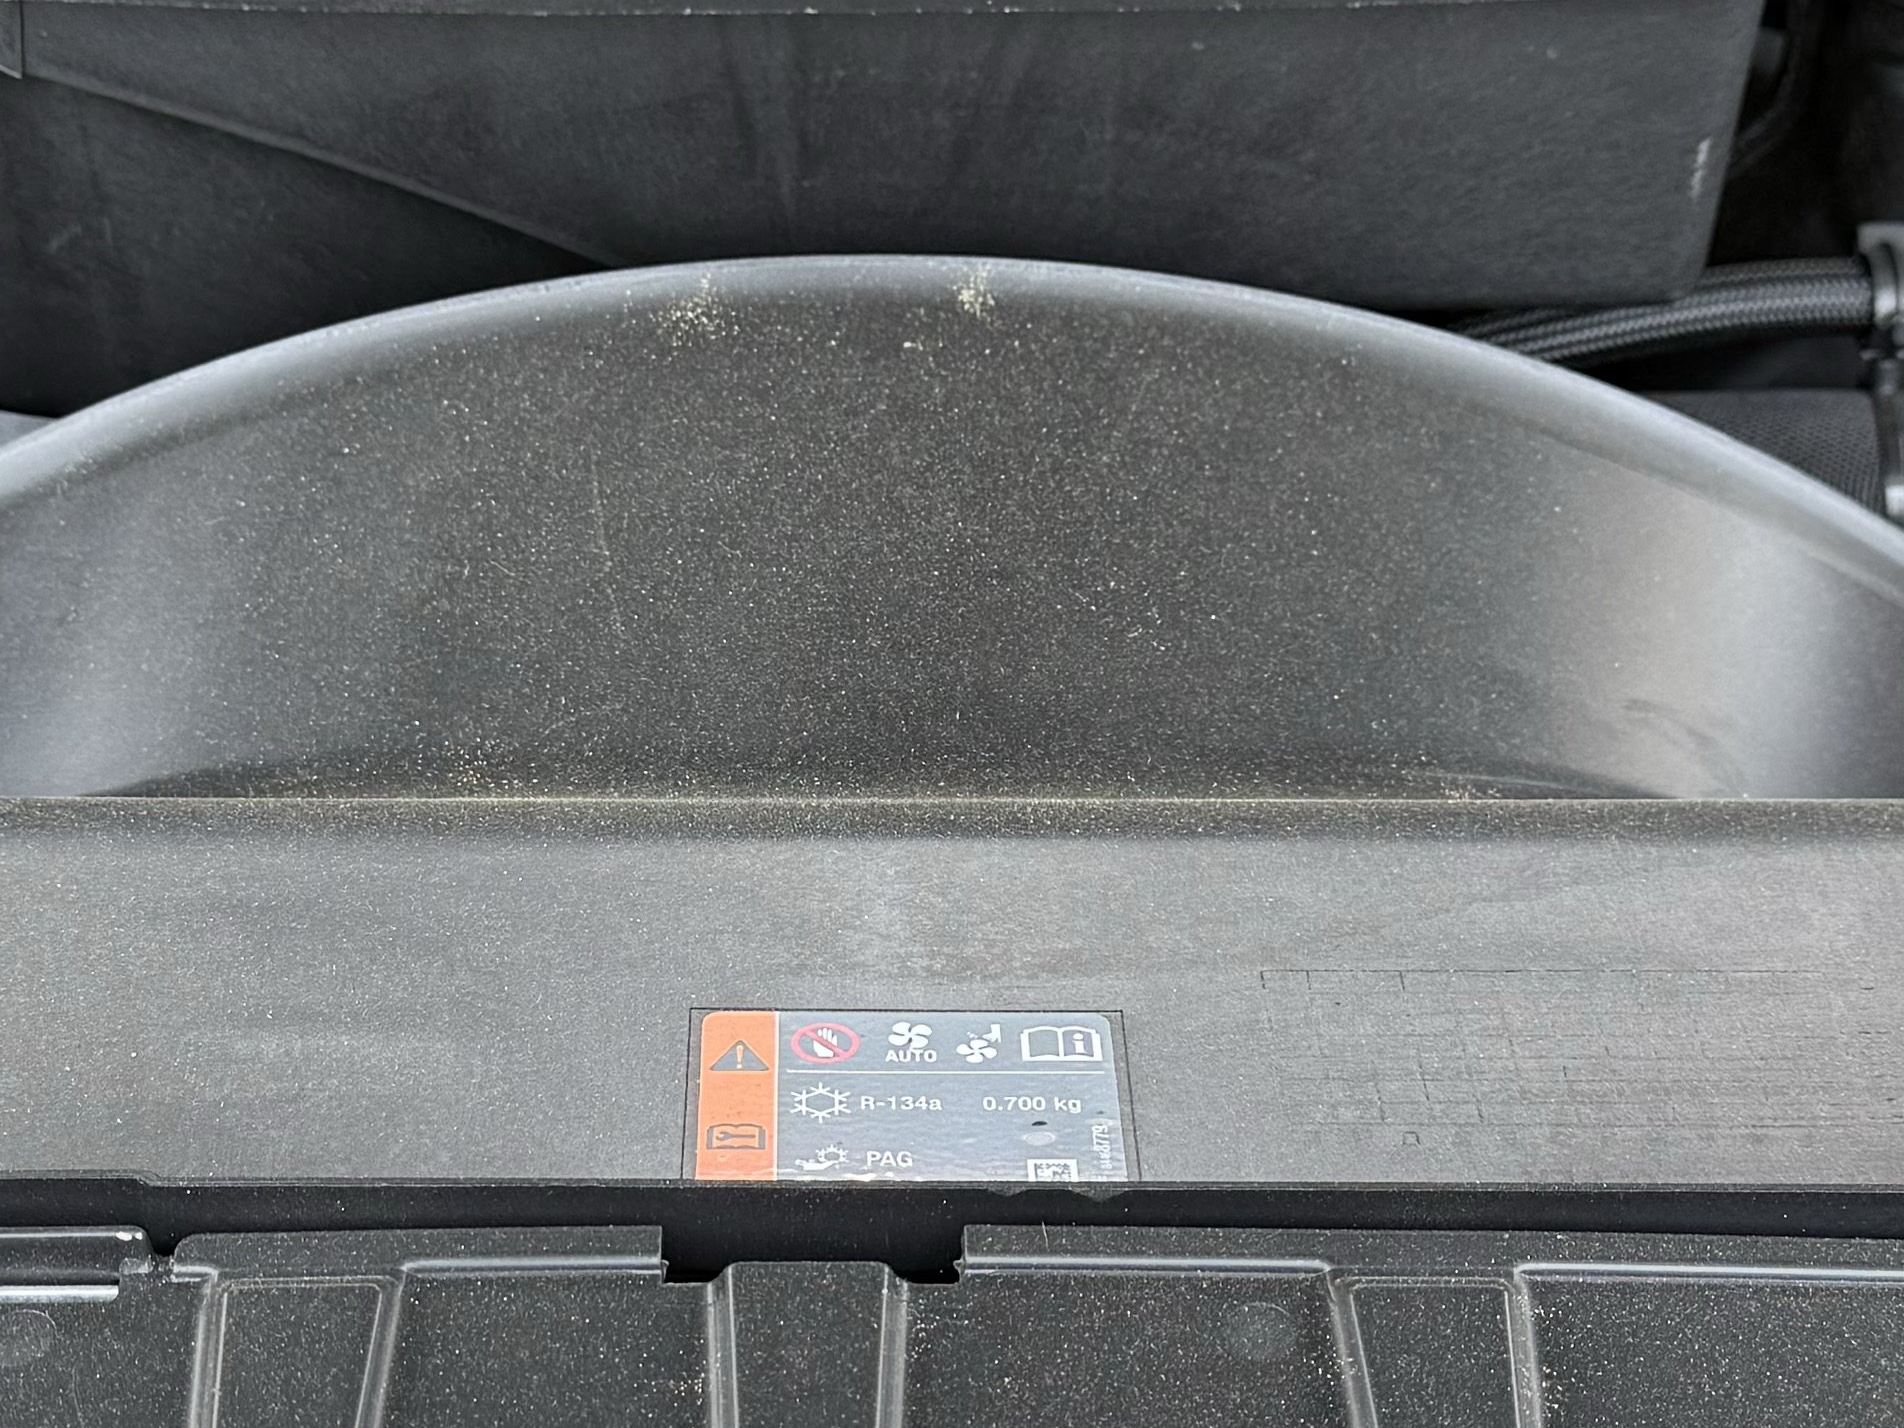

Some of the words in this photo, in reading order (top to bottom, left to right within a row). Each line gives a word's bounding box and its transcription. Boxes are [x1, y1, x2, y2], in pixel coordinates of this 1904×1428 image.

[885, 1049, 938, 1063] AUTO
[860, 1095, 943, 1111] R-134a
[982, 1096, 1046, 1111] 0.700
[1054, 1096, 1082, 1114] kg
[866, 1150, 914, 1168] PAG
